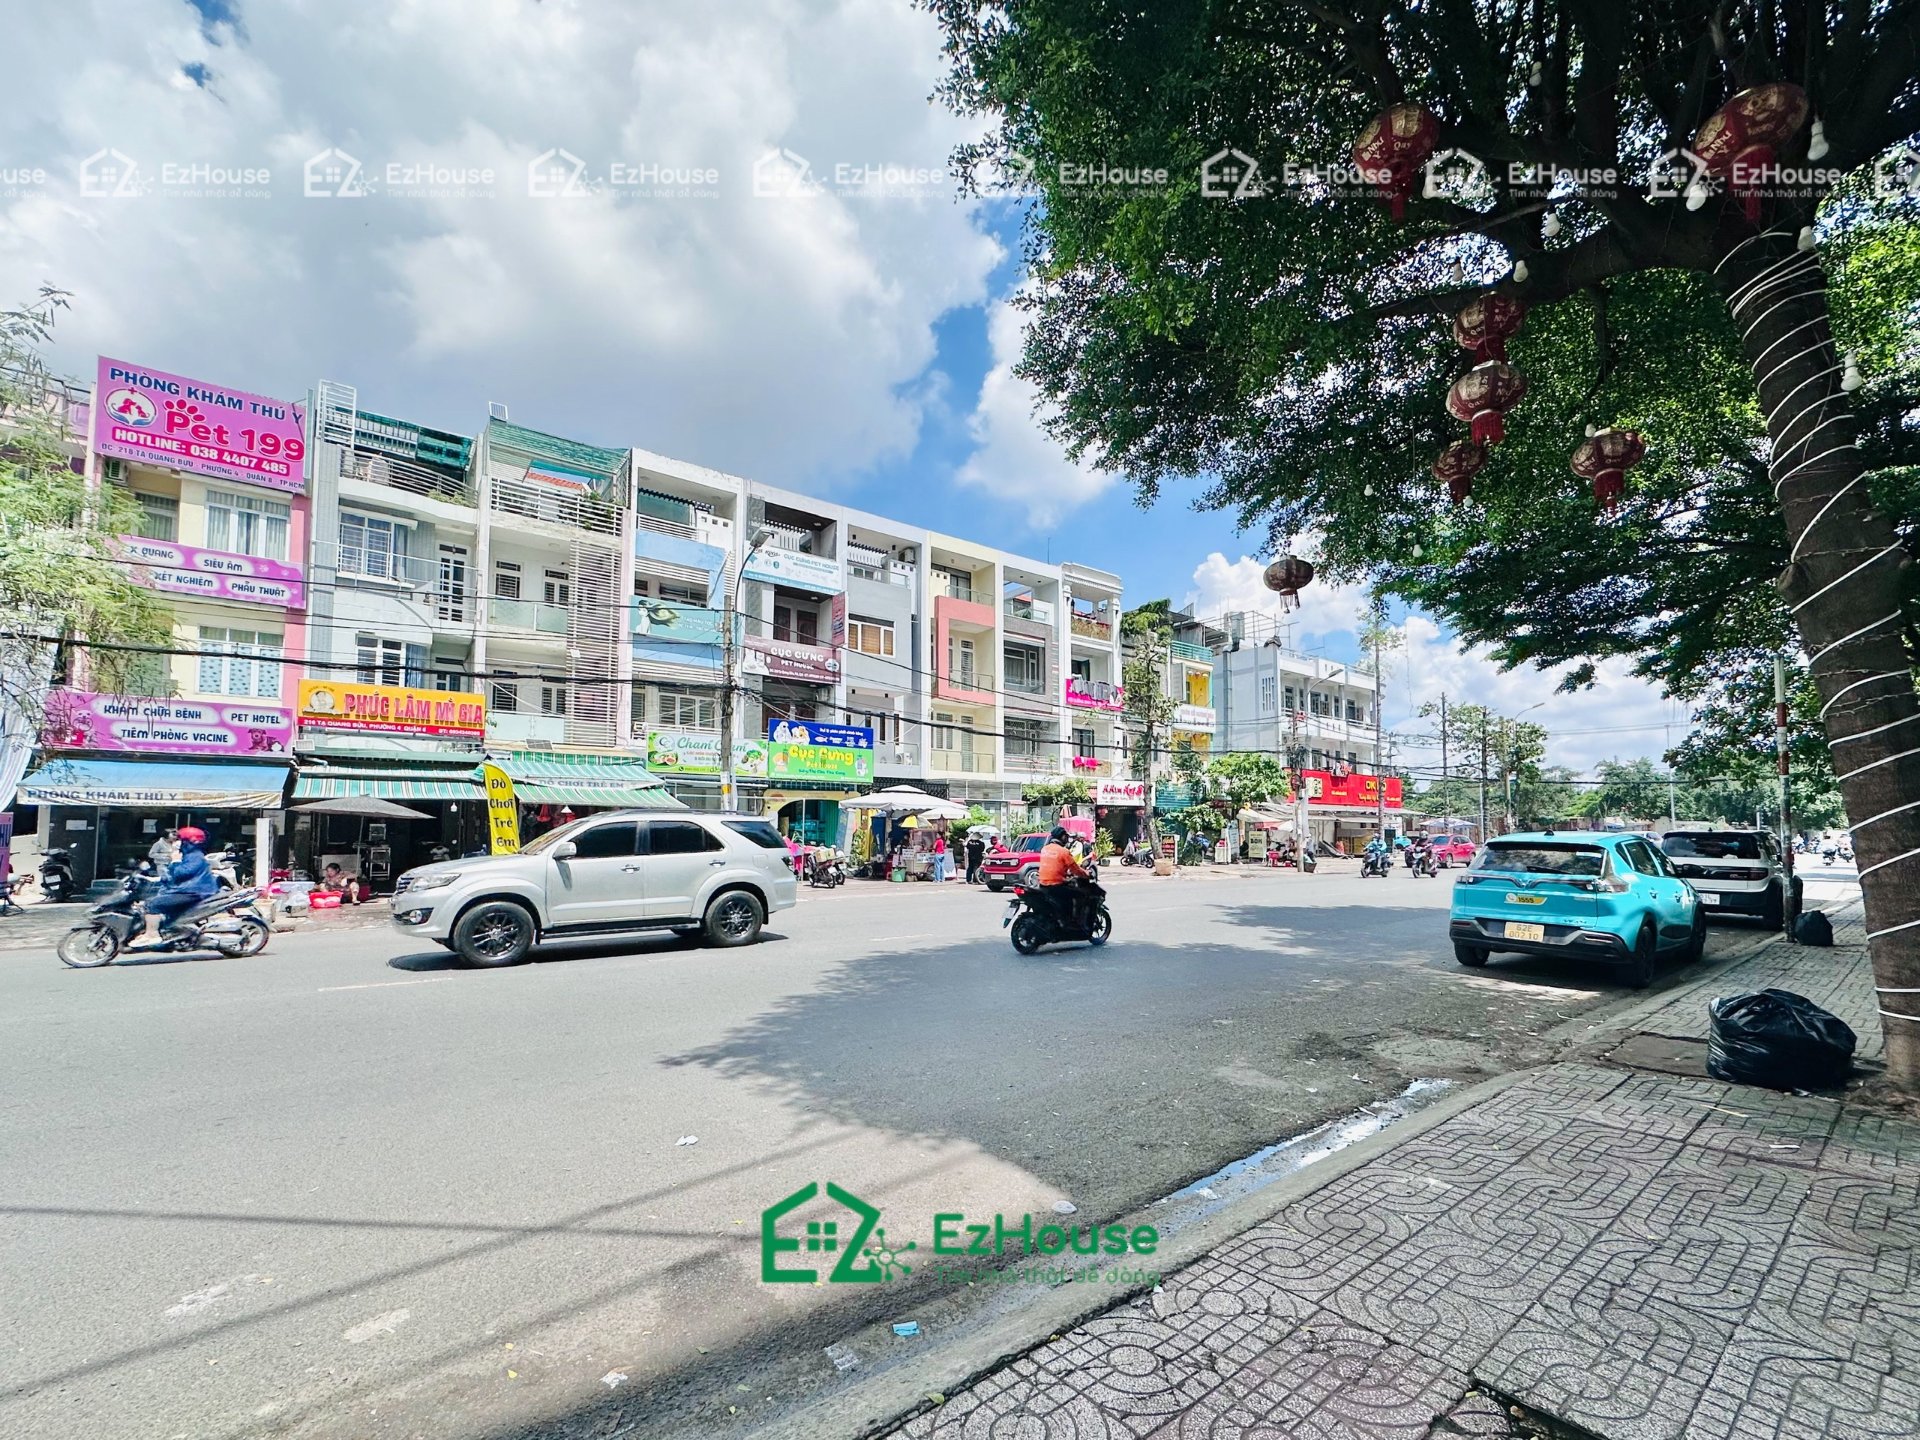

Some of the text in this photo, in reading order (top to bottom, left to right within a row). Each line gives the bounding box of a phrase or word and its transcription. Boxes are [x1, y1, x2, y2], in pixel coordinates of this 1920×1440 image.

[110, 367, 304, 424] PHÒNG KHÁM THÚ Y
[166, 411, 305, 461] Pet 199
[115, 429, 287, 474] HOTLINE: 038 4407 485
[149, 453, 175, 463] QUANG
[142, 548, 174, 559] QUANG
[204, 557, 224, 568] SIÊU
[176, 707, 201, 721] BỆNH
[394, 693, 430, 721] LÂM
[435, 697, 455, 722] MÌ
[459, 702, 483, 726] GIA
[231, 712, 281, 724] PET HOTEL
[121, 727, 228, 743] TIÊM PHÒNG VACINE
[86, 788, 130, 800] KHÁM
[134, 789, 164, 801] THÚ
[168, 792, 178, 800] Y
